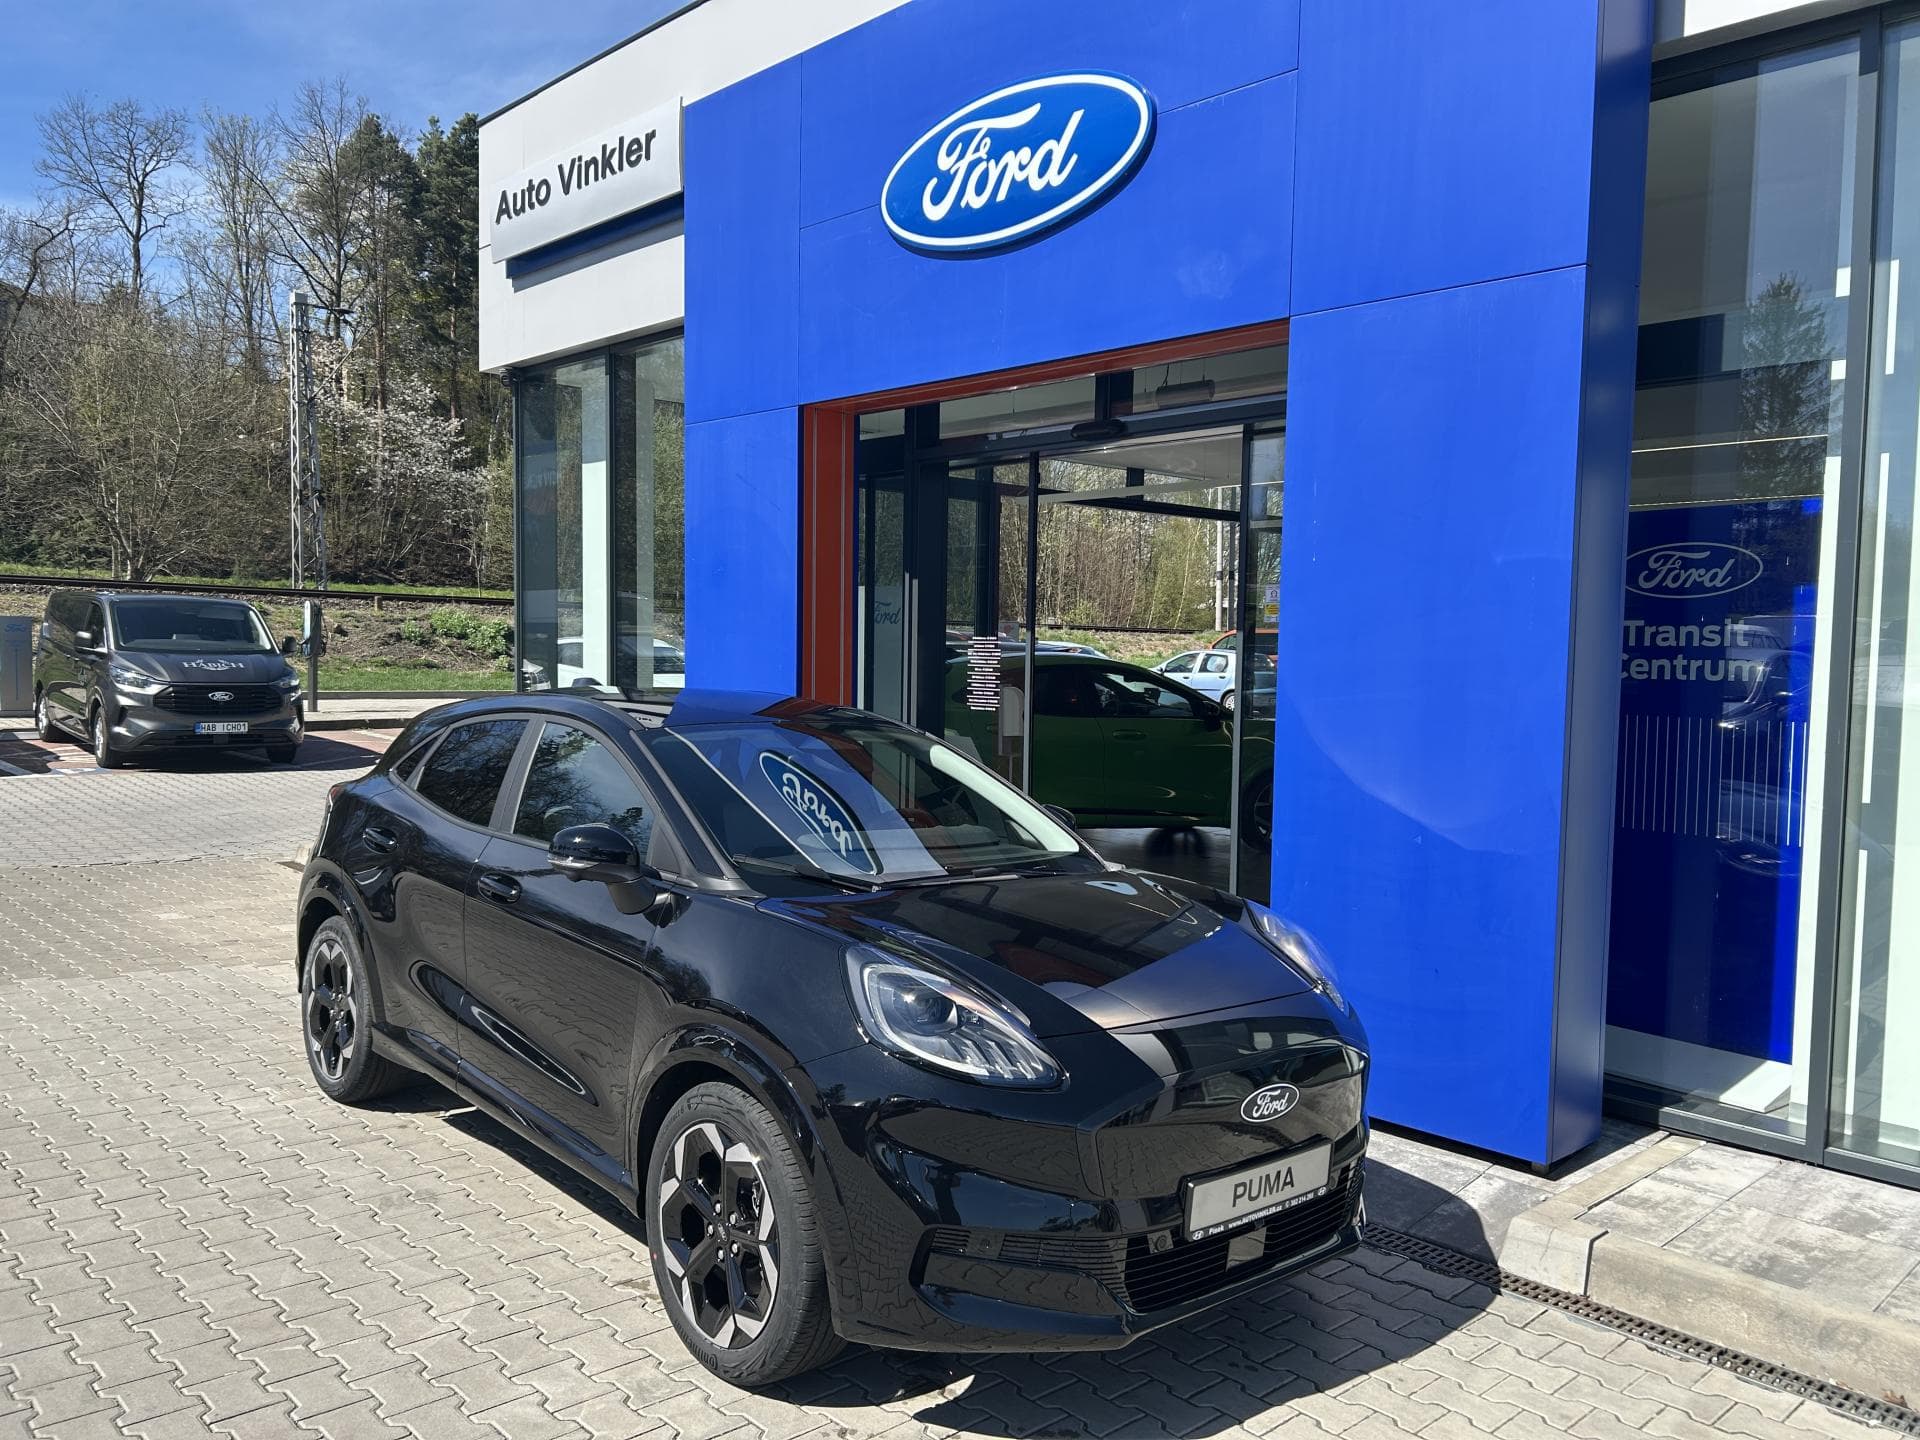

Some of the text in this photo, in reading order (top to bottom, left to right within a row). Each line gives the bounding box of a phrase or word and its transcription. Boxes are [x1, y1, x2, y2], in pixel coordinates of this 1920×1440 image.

[495, 129, 656, 225] Auto Vinkler
[922, 102, 1084, 221] Ford
[1638, 550, 1735, 589] Ford
[1623, 618, 1750, 647] Transit
[1252, 1089, 1289, 1118] Ford
[1232, 1166, 1295, 1208] PUMA
